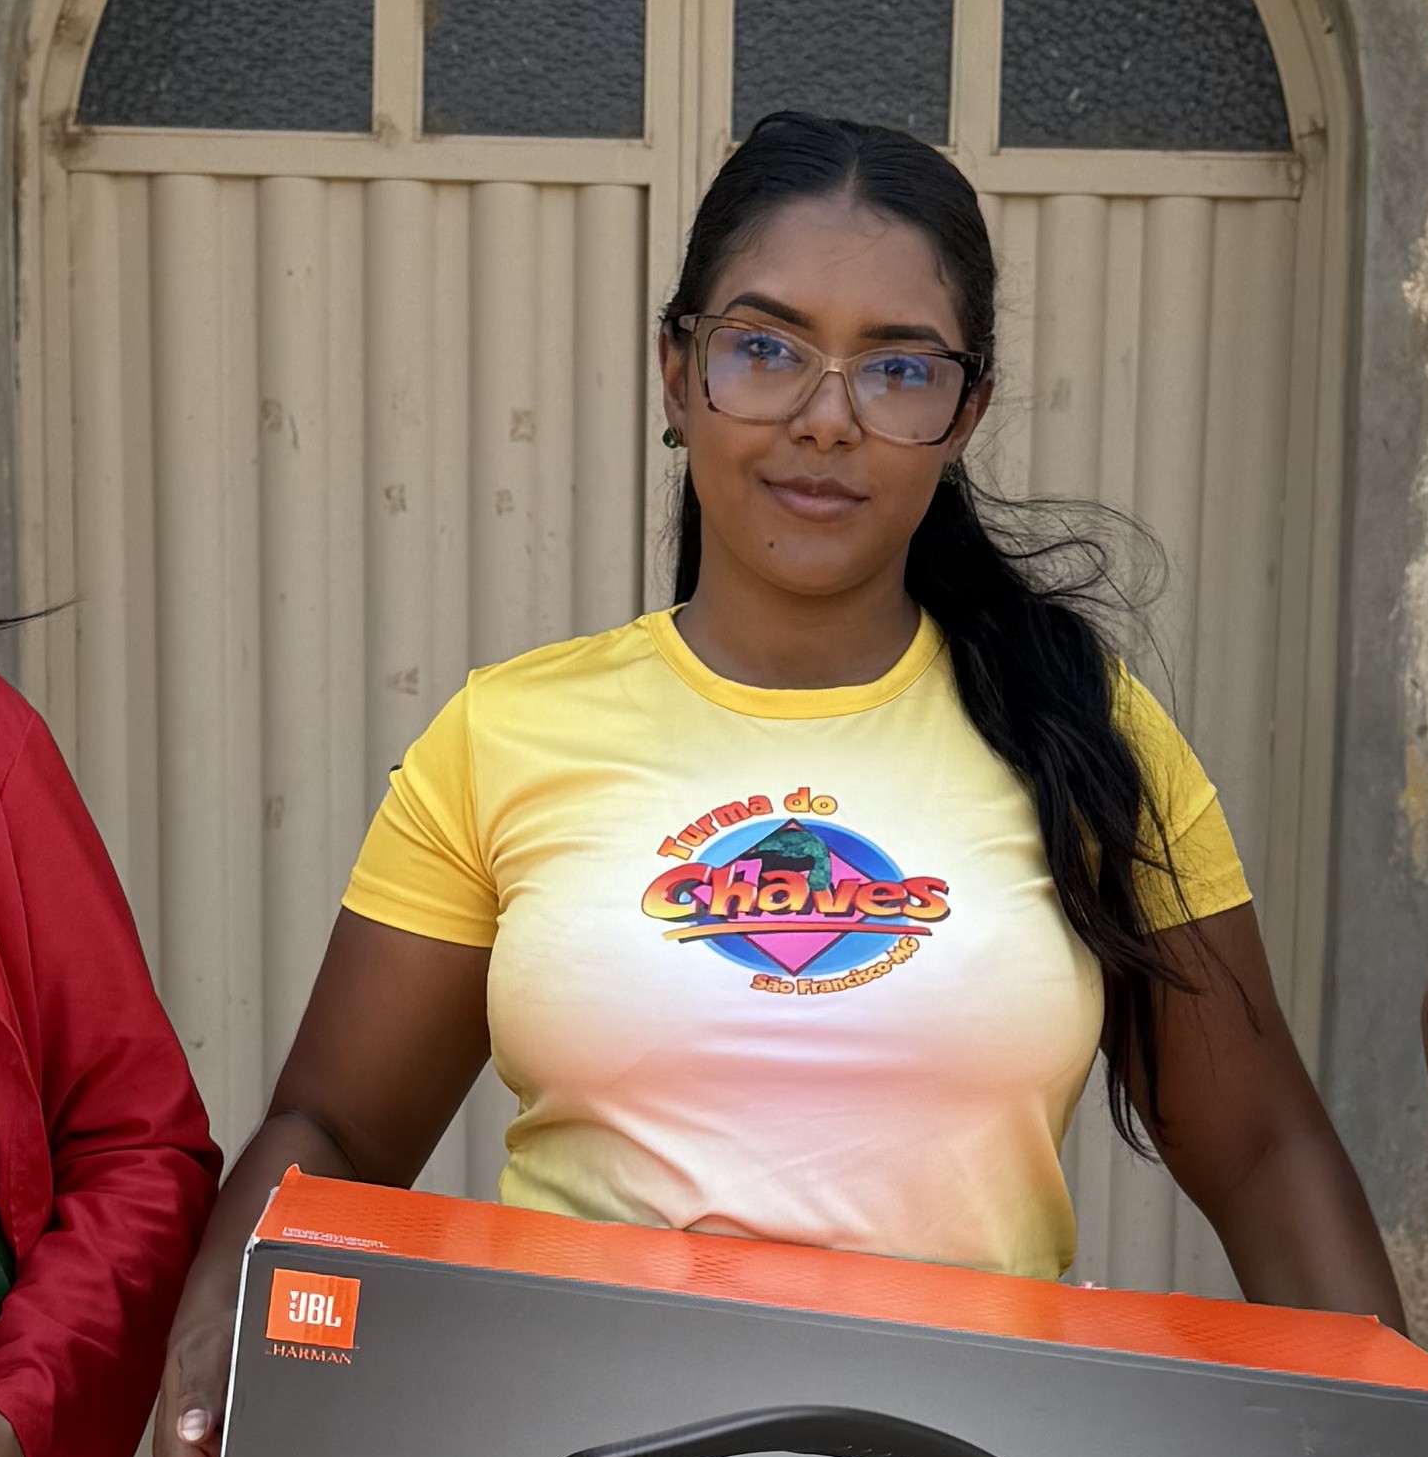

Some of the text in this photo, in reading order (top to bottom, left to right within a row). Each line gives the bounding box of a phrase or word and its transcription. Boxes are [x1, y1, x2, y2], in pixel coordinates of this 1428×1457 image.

[657, 787, 838, 860] Turma do
[641, 861, 951, 923] Chaves
[750, 935, 920, 995] São Francisco-MG
[288, 1290, 342, 1328] JBL
[272, 1343, 352, 1365] HARMAN
